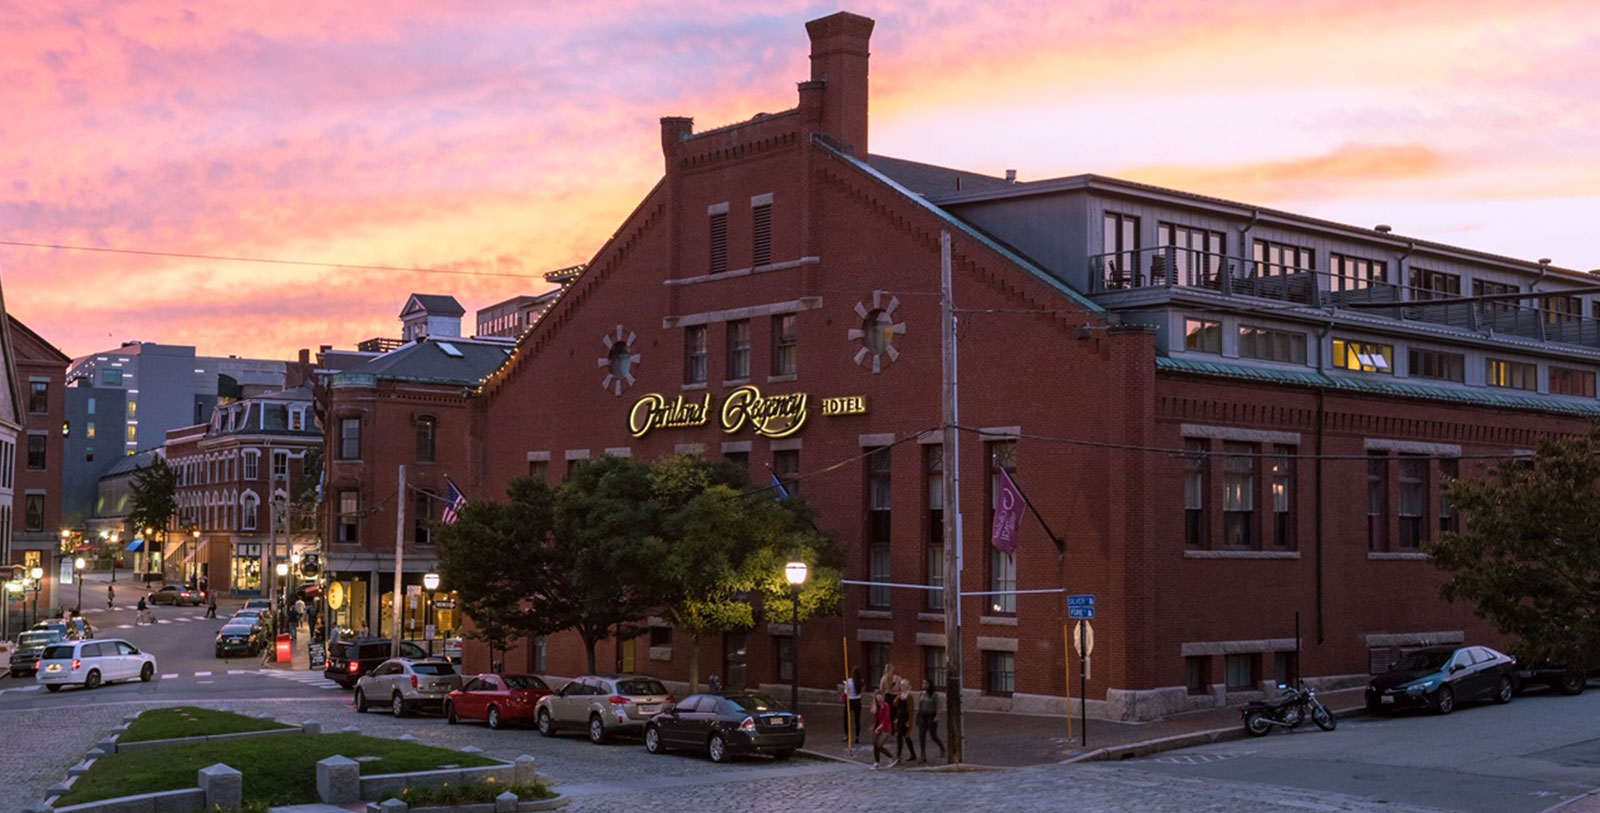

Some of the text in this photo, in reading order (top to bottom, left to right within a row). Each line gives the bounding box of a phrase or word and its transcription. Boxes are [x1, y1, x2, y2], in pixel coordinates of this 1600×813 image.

[628, 385, 866, 437] Portland Regency HOTEL
